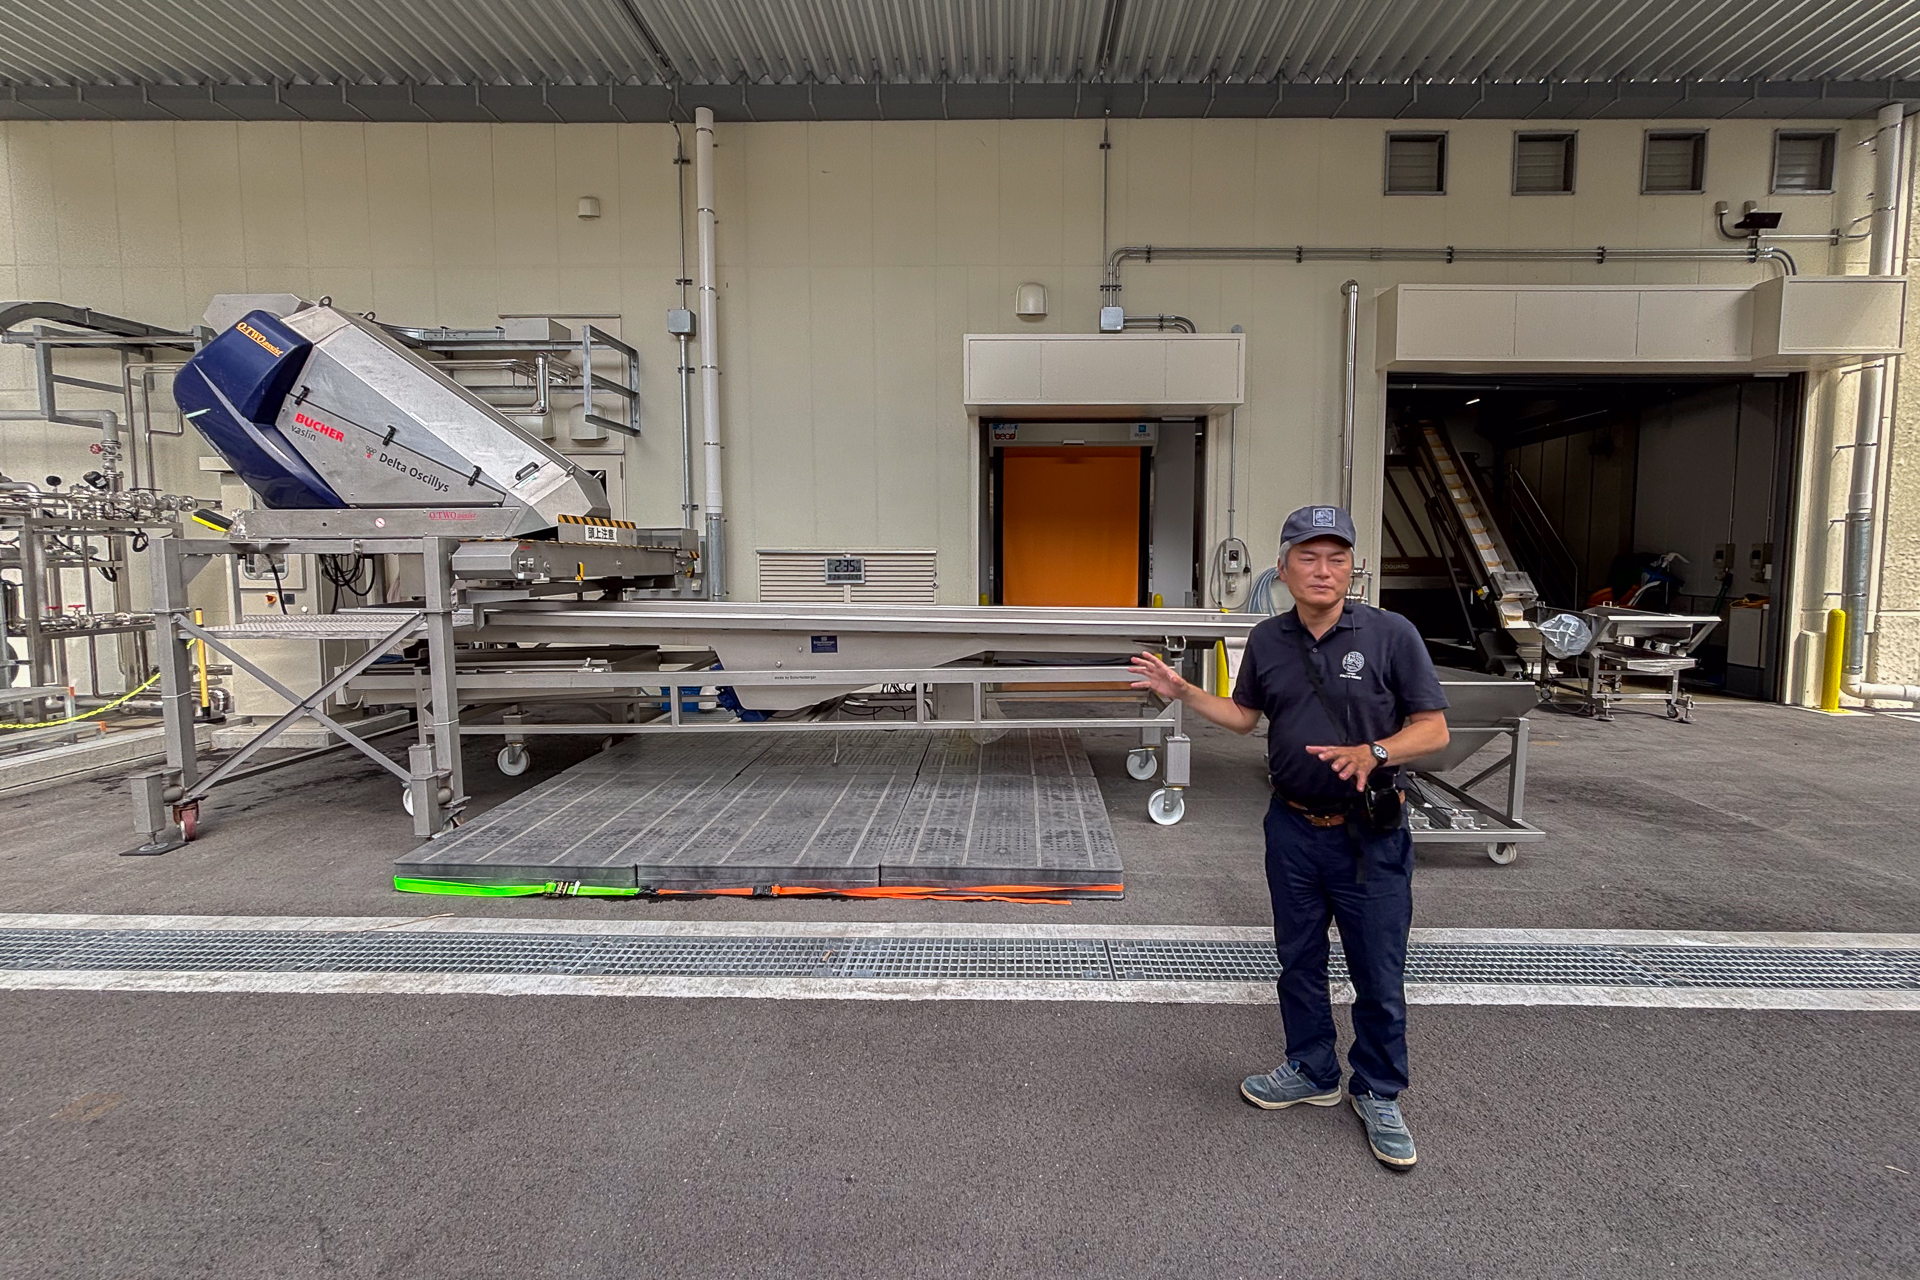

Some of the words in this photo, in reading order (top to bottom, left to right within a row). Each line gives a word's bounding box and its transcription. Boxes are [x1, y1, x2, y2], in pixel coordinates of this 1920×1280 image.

[291, 425, 317, 441] vaslin
[294, 412, 345, 442] BUCHER
[379, 453, 408, 473] Delta
[409, 467, 450, 493] Oscillys
[587, 526, 616, 541] 頭上注意
